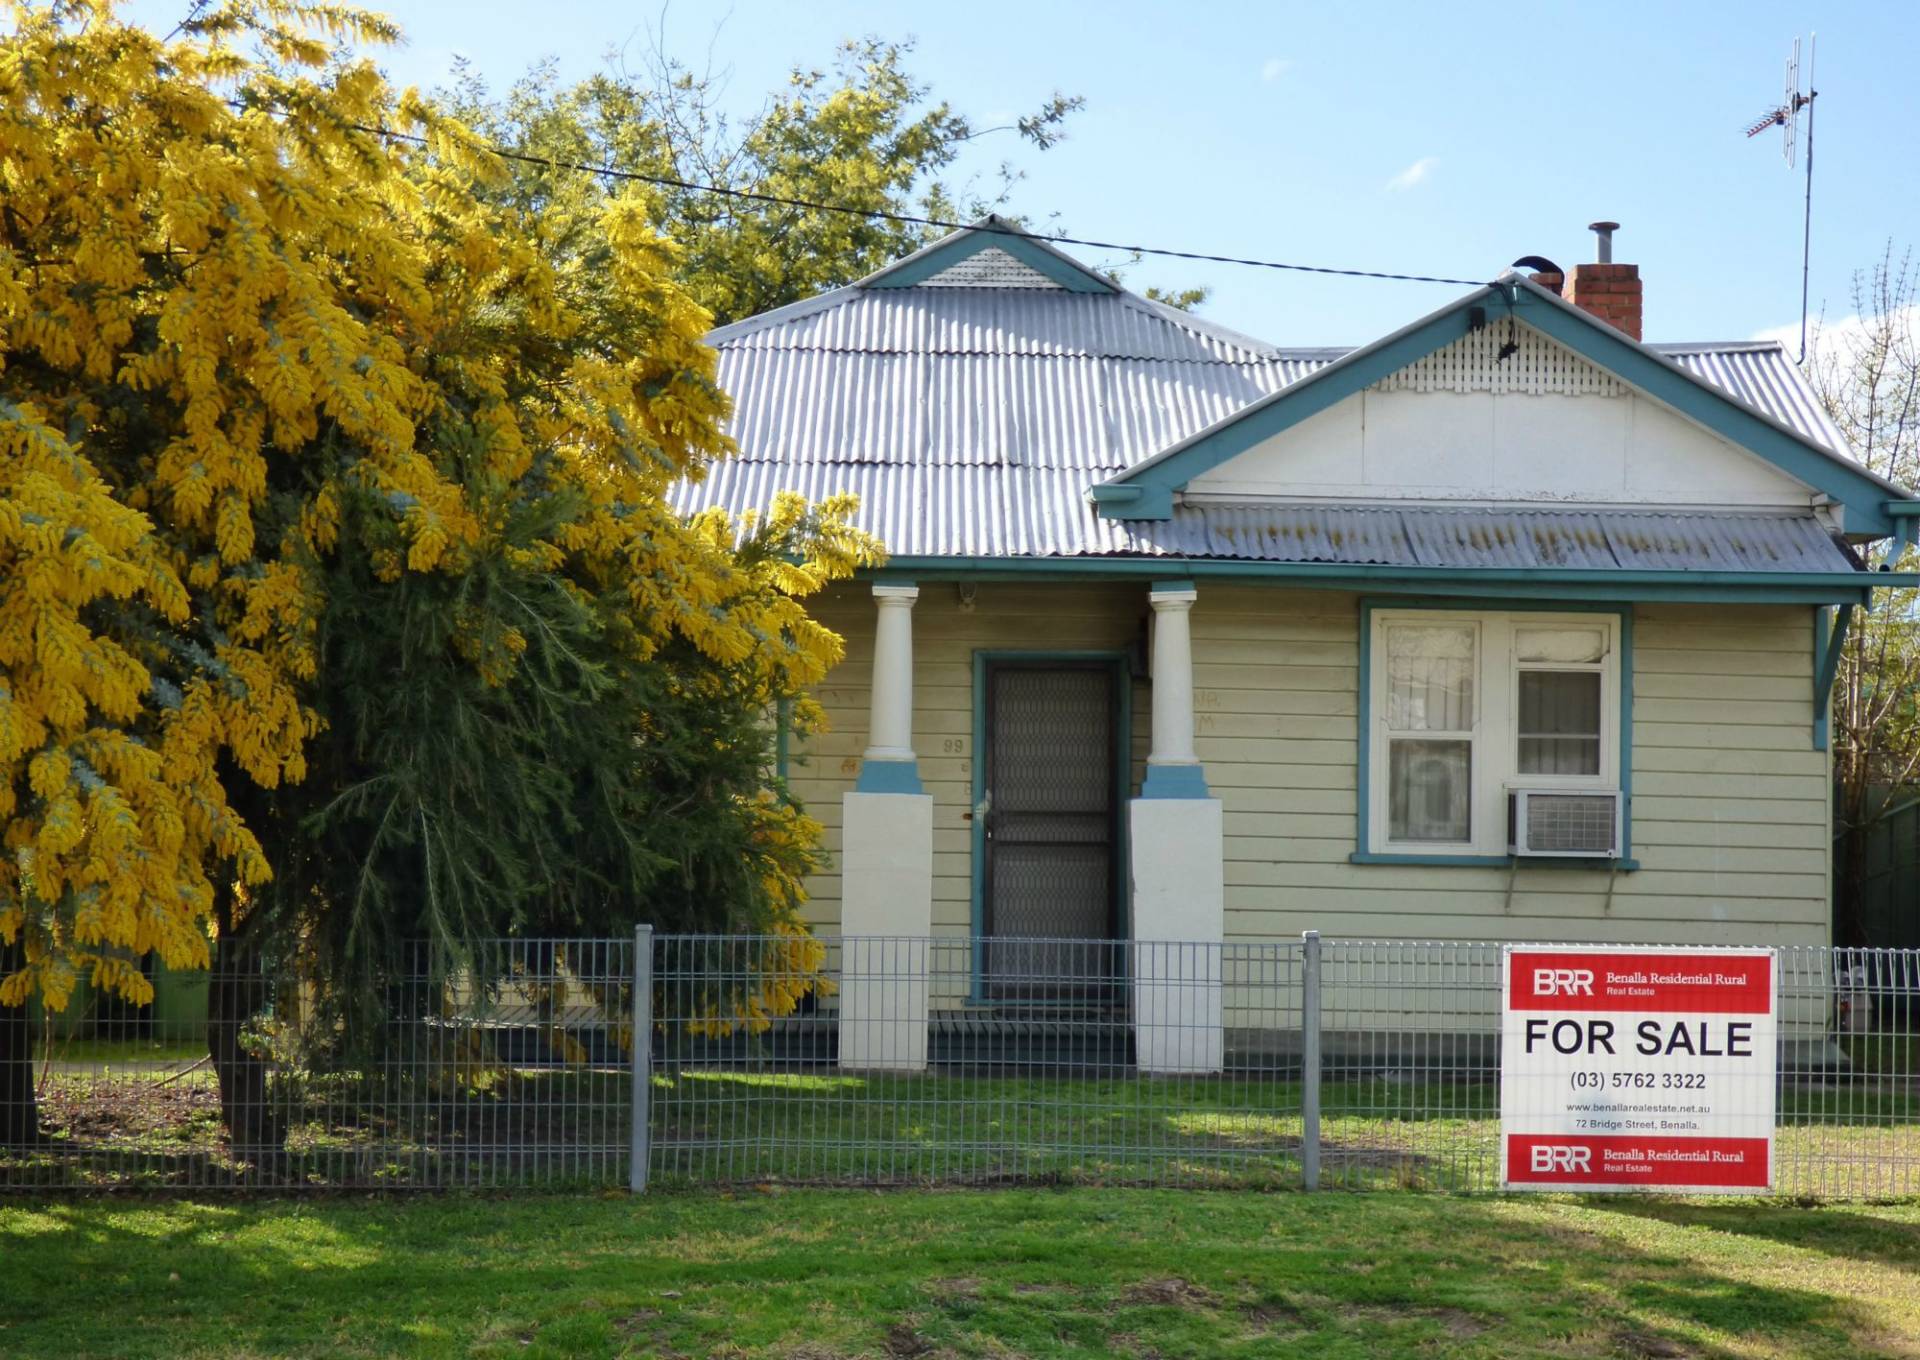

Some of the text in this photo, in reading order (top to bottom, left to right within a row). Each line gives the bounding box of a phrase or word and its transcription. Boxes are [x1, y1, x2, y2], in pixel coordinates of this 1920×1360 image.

[1533, 969, 1594, 996] BRR
[1606, 972, 1746, 985] Benalla Residential Rural
[1607, 987, 1655, 996] Real Estate
[1525, 1019, 1752, 1057] FOR SALE
[1570, 1072, 1705, 1090] (03) 5762 3322
[1567, 1103, 1710, 1113] www.benallarealestate.net.au
[1576, 1120, 1700, 1130] 72 Bridge Street, Benalla.
[1531, 1145, 1591, 1173] BRR
[1604, 1149, 1744, 1162] Benalla Residential Rural
[1604, 1164, 1652, 1172] Real Estate
